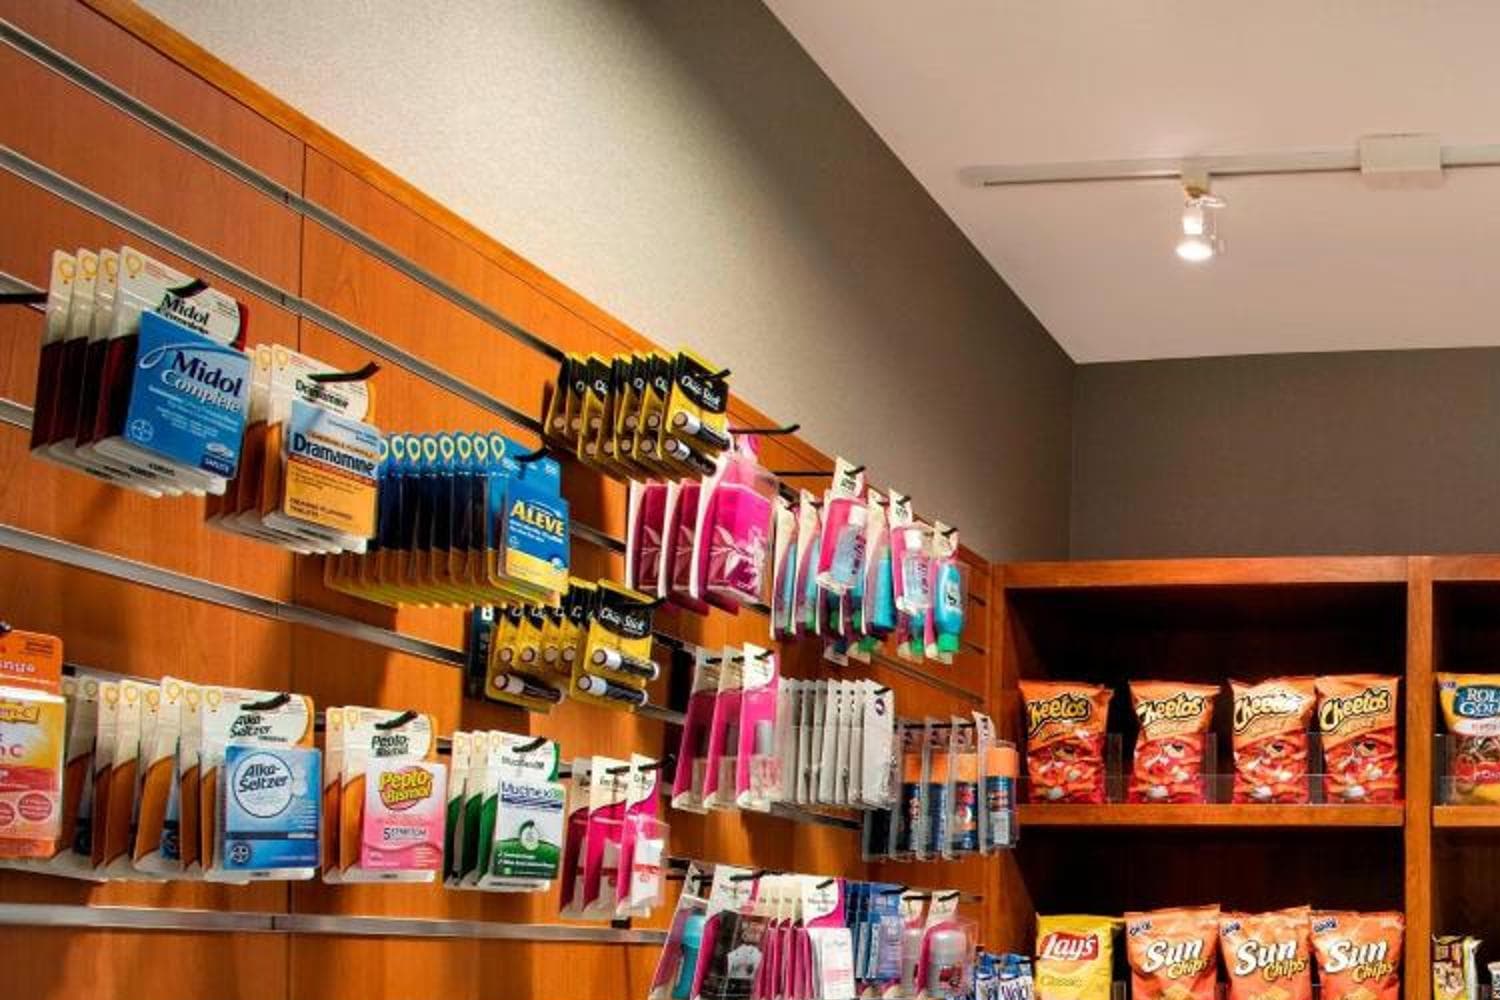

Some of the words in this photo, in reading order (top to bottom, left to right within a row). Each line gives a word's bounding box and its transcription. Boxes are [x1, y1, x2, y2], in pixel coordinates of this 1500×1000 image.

[161, 290, 210, 327] Midol
[160, 369, 242, 413] Complete
[173, 350, 243, 398] Midol
[292, 432, 375, 476] Dramamine
[510, 498, 566, 538] ALEVE
[1319, 687, 1392, 732] Cheetos
[238, 776, 289, 793] Seltzer
[242, 763, 281, 778] Alka-
[1042, 931, 1095, 961] Lay's
[1143, 939, 1204, 973] Sun
[1233, 939, 1297, 976] Sun
[1324, 939, 1387, 974] Sun
[1262, 958, 1308, 982] Chips
[1350, 958, 1394, 983] Chips
